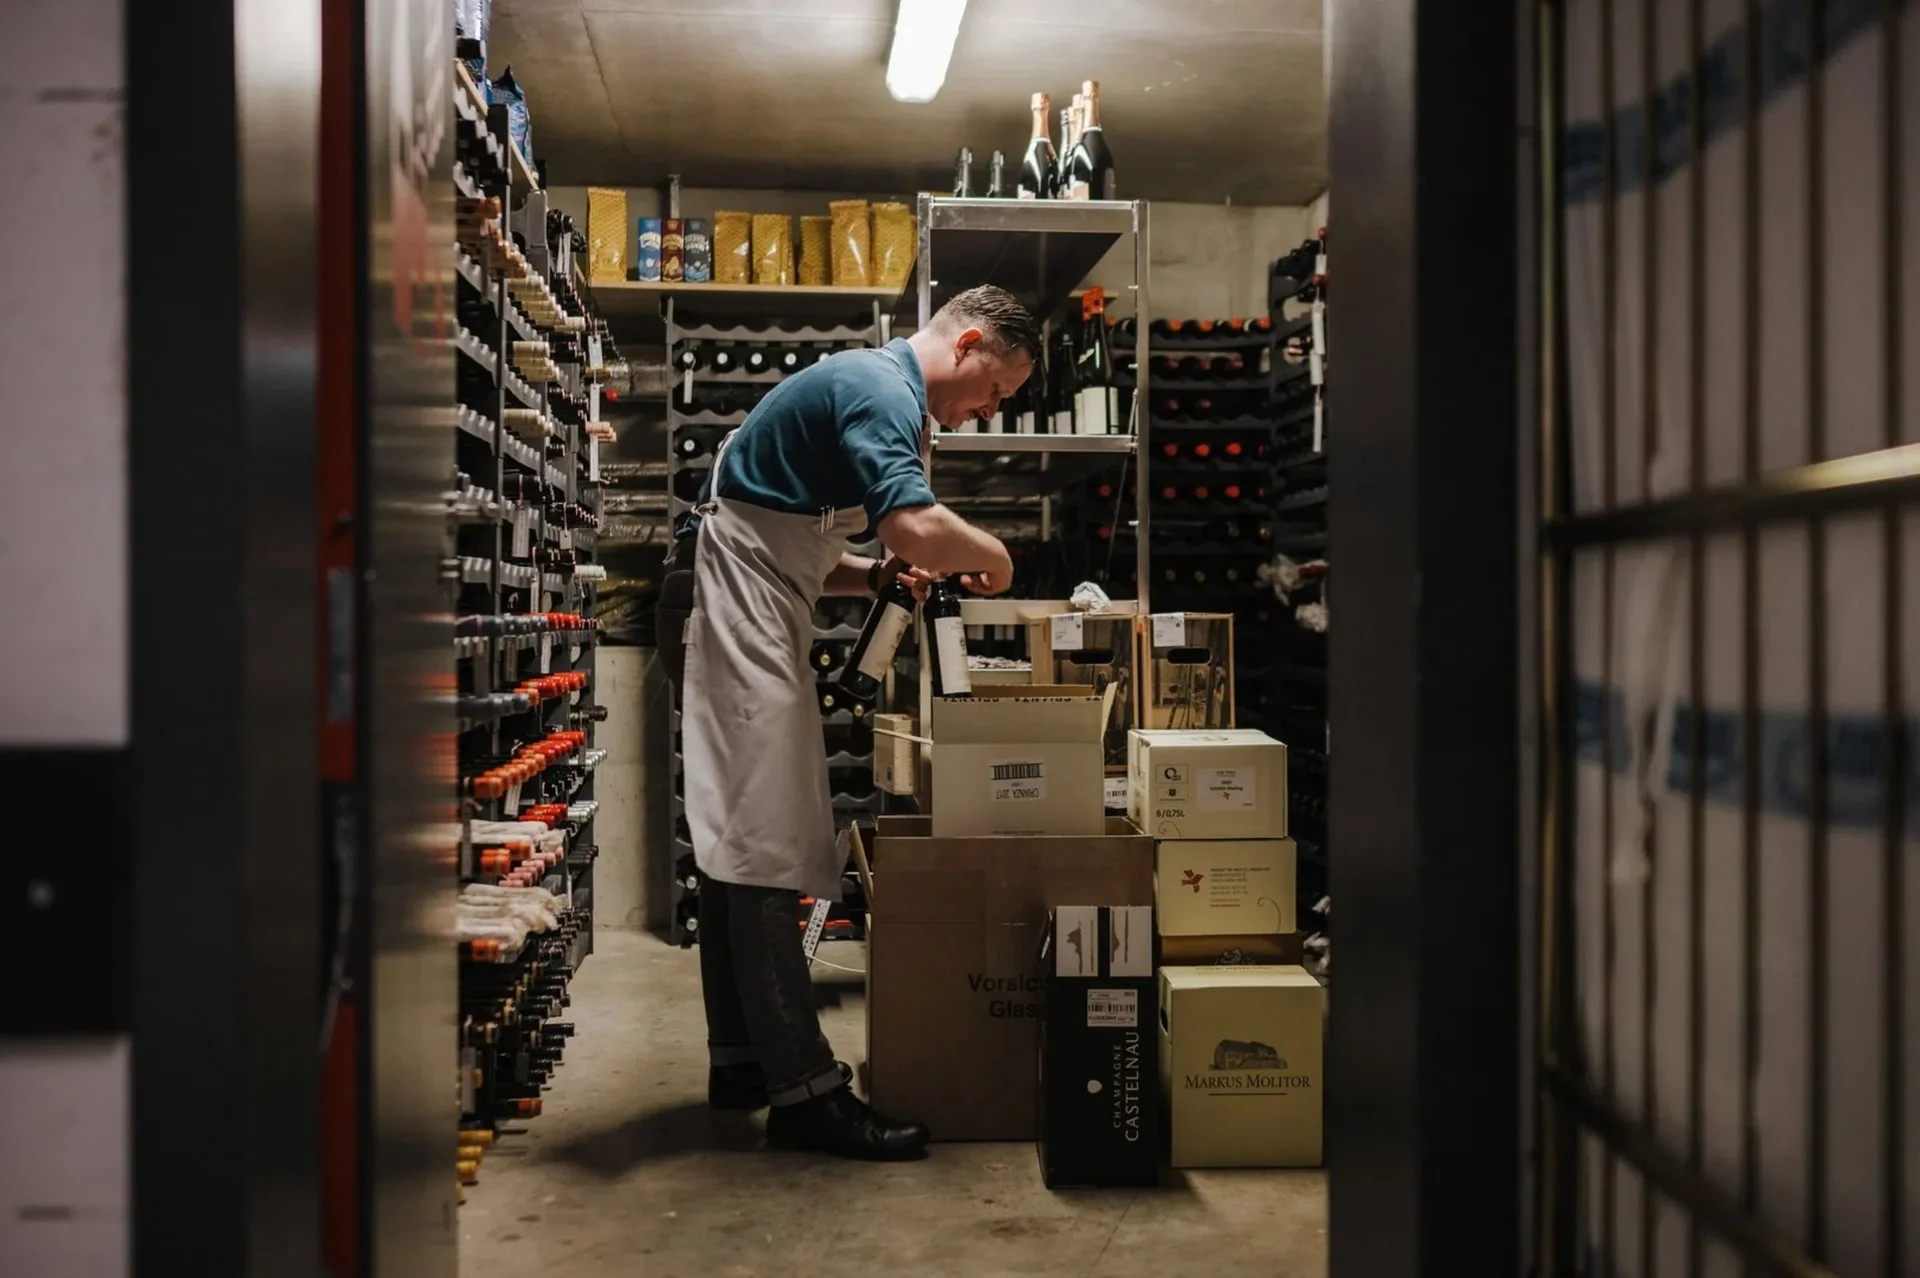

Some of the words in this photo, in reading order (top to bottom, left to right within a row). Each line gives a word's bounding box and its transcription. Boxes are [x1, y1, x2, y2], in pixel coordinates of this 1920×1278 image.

[967, 973, 1039, 993] Vorsic
[989, 1000, 1038, 1018] Glas
[1113, 1044, 1122, 1129] CHAMPAGNE
[1125, 1031, 1140, 1142] CASTELNAU
[1184, 1074, 1243, 1089] MARKUS
[1246, 1074, 1311, 1089] MOLITOR
